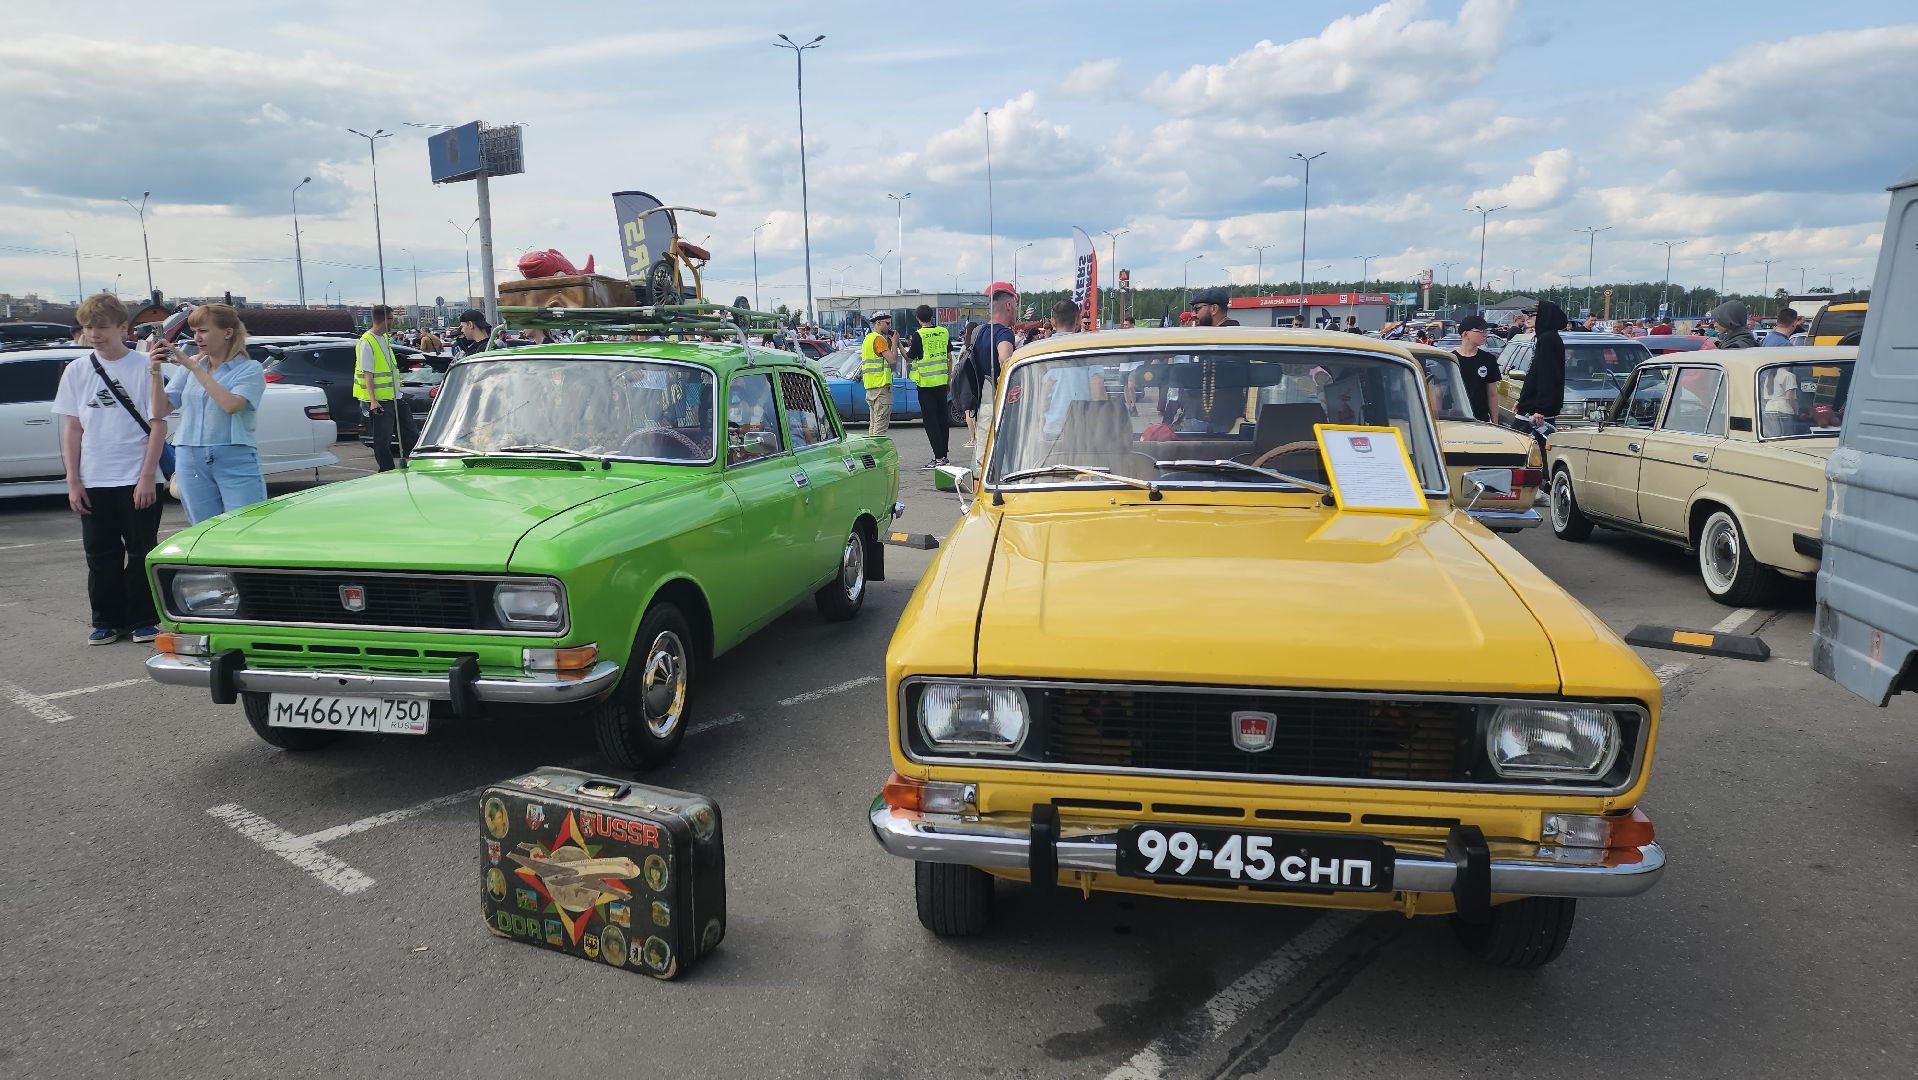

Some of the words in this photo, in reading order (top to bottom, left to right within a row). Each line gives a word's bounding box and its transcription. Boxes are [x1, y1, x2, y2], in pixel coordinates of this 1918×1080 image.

[383, 699, 421, 721] 750
[390, 721, 410, 729] RUS
[596, 813, 659, 849] USSR
[497, 910, 542, 940] DDR
